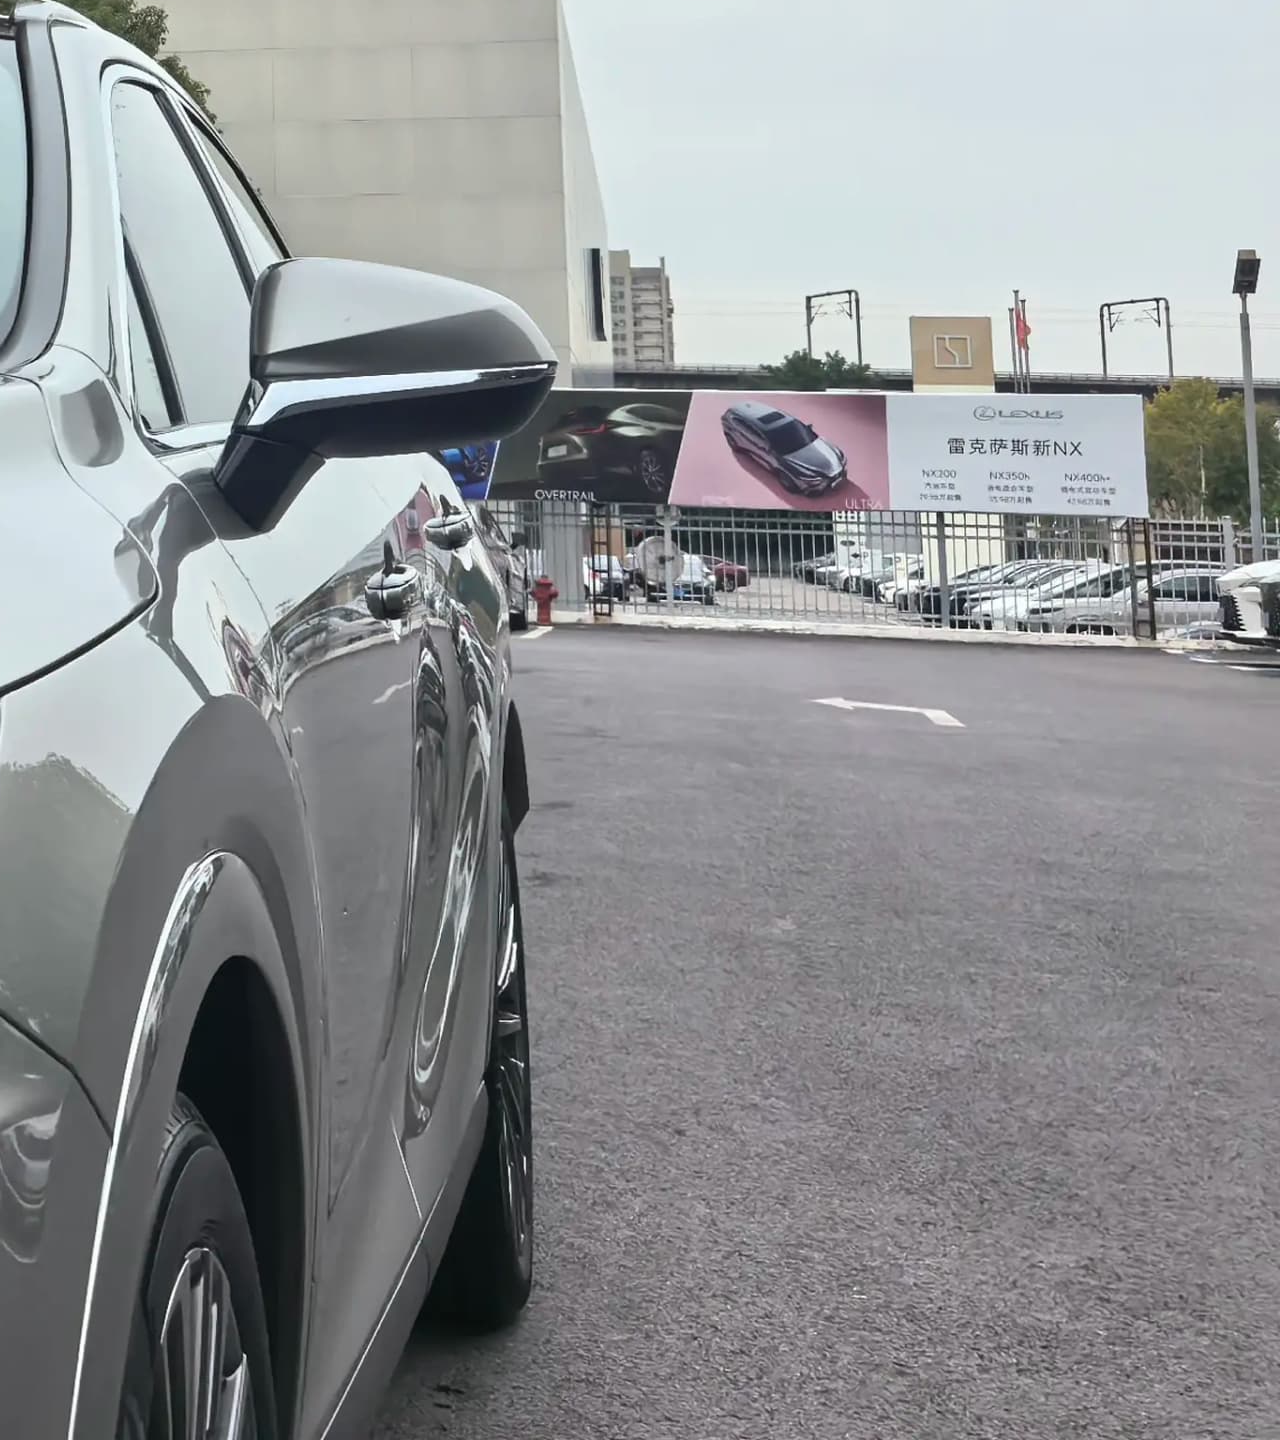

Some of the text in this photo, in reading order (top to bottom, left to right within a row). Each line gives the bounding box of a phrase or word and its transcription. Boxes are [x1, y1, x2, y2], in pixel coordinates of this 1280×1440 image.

[998, 409, 1064, 420] LEXUS
[947, 437, 1083, 457] 雷克萨斯新NX
[534, 489, 597, 501] OVERTRAIL
[845, 497, 883, 510] ULTRA
